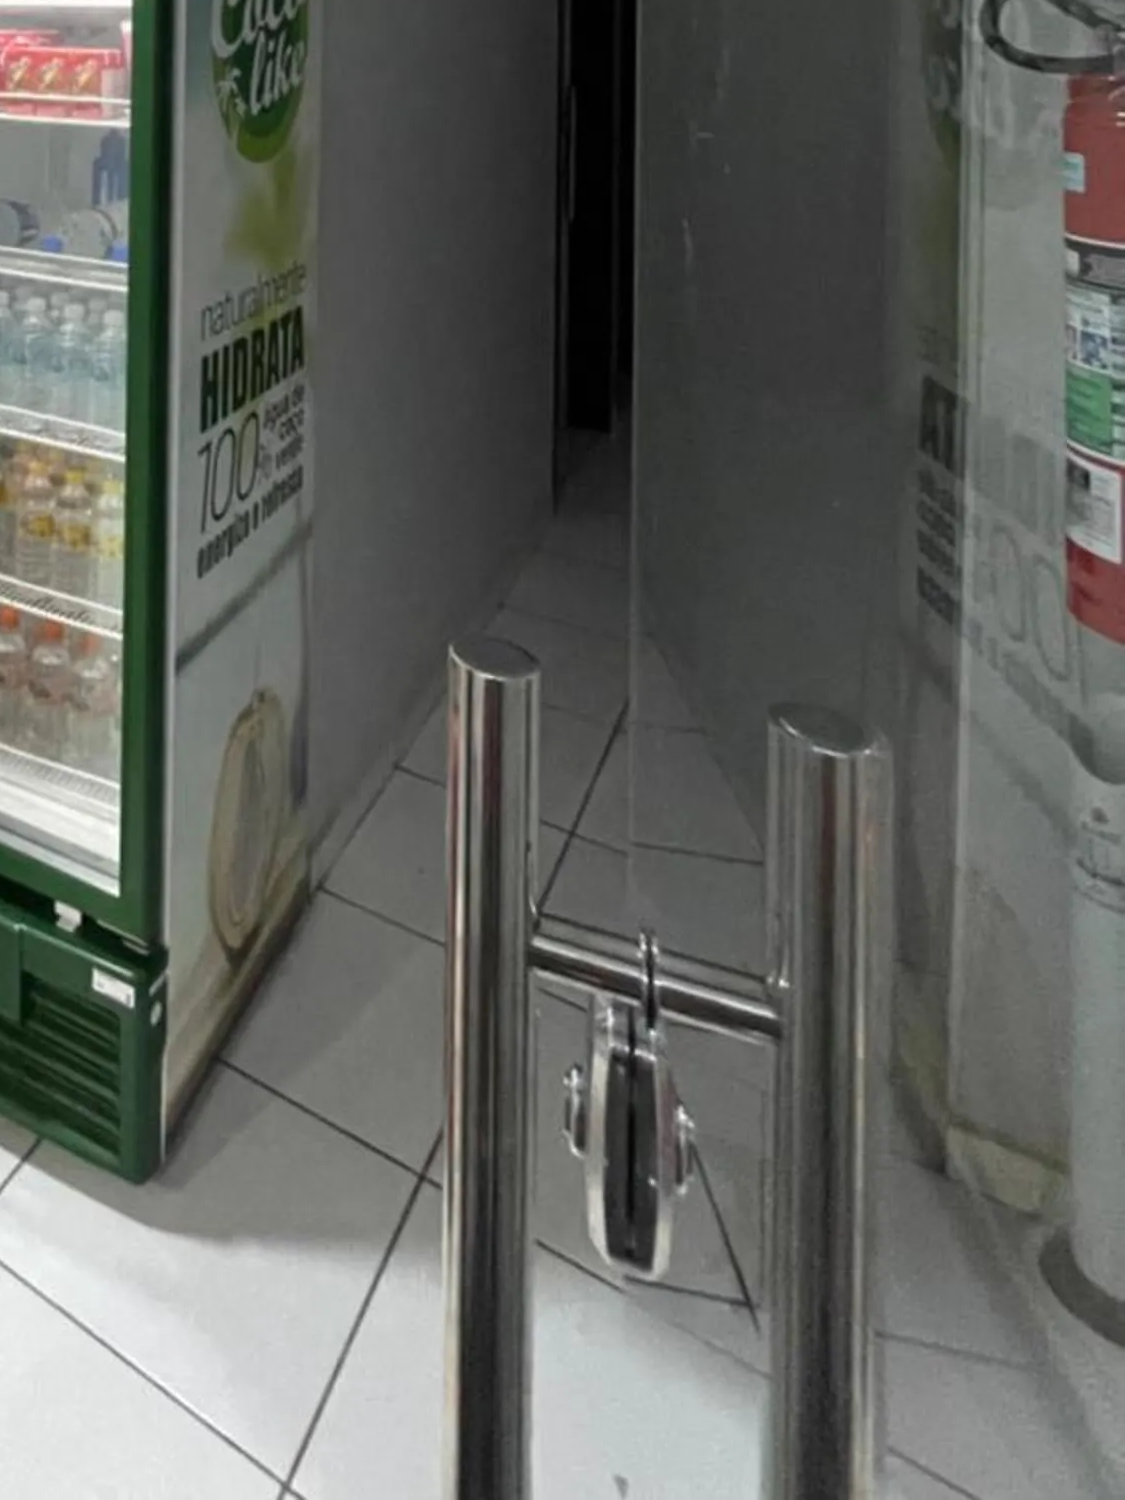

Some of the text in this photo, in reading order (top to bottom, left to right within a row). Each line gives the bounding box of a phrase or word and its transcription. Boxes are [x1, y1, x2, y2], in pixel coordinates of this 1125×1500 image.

[249, 29, 304, 116] like
[200, 262, 306, 342] naturalmente
[199, 305, 305, 434] HIDRATA
